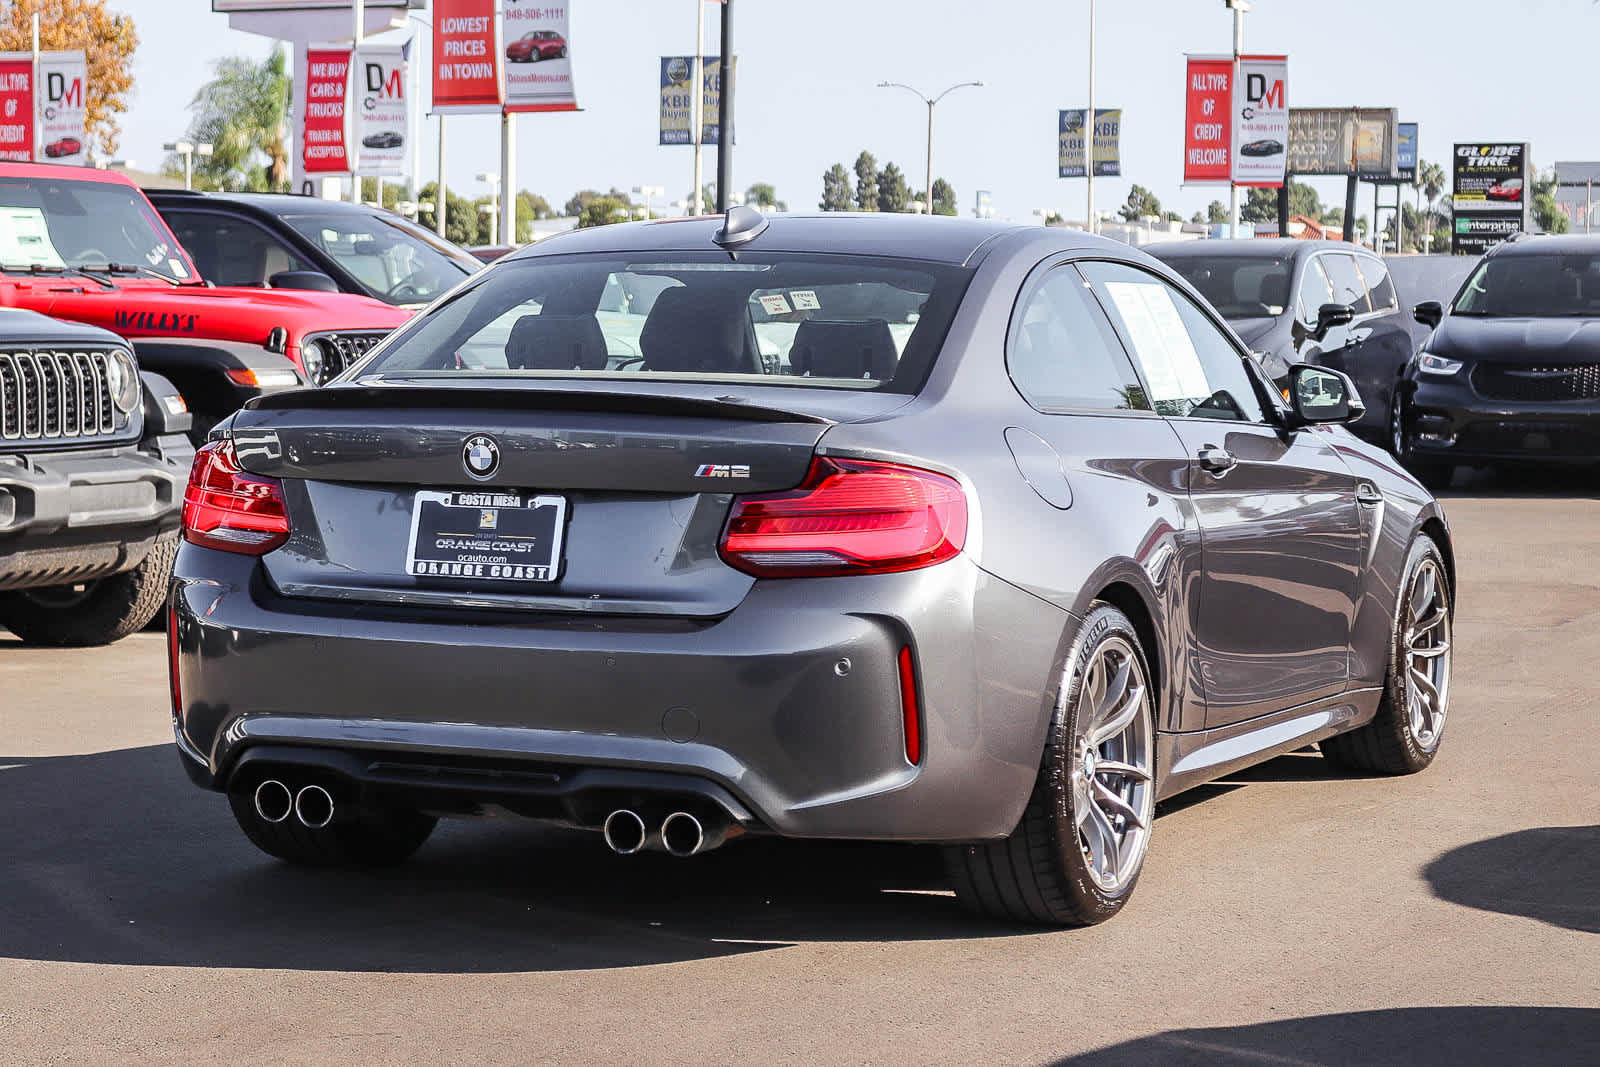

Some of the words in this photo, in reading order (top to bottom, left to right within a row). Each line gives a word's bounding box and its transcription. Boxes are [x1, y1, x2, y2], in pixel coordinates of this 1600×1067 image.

[440, 17, 490, 34] LOWEST
[443, 40, 487, 57] PRICES
[312, 62, 327, 77] WE
[328, 62, 347, 77] BUY
[439, 63, 452, 81] IN
[454, 63, 493, 79] TOWN
[9, 73, 29, 91] TYPE
[310, 82, 335, 98] CARS
[335, 83, 344, 97] &
[1192, 74, 1208, 91] ALL
[1208, 74, 1228, 91] TYPE
[5, 99, 18, 117] OF
[309, 103, 344, 118] TRUCKS
[1203, 99, 1216, 116] OF
[1194, 124, 1223, 140] CREDIT
[307, 146, 345, 159] ACCEPTED
[1188, 149, 1227, 165] WELCOME
[1467, 156, 1511, 166] TIRE
[1461, 221, 1519, 233] enterprise
[709, 464, 750, 478] M2
[458, 494, 492, 505] COSTA
[493, 495, 521, 507] MESA
[435, 538, 491, 551] ORANGE
[492, 541, 535, 552] COAST
[457, 553, 507, 563] ocauto.com
[416, 561, 484, 576] ORANGE
[490, 565, 547, 579] COAST
